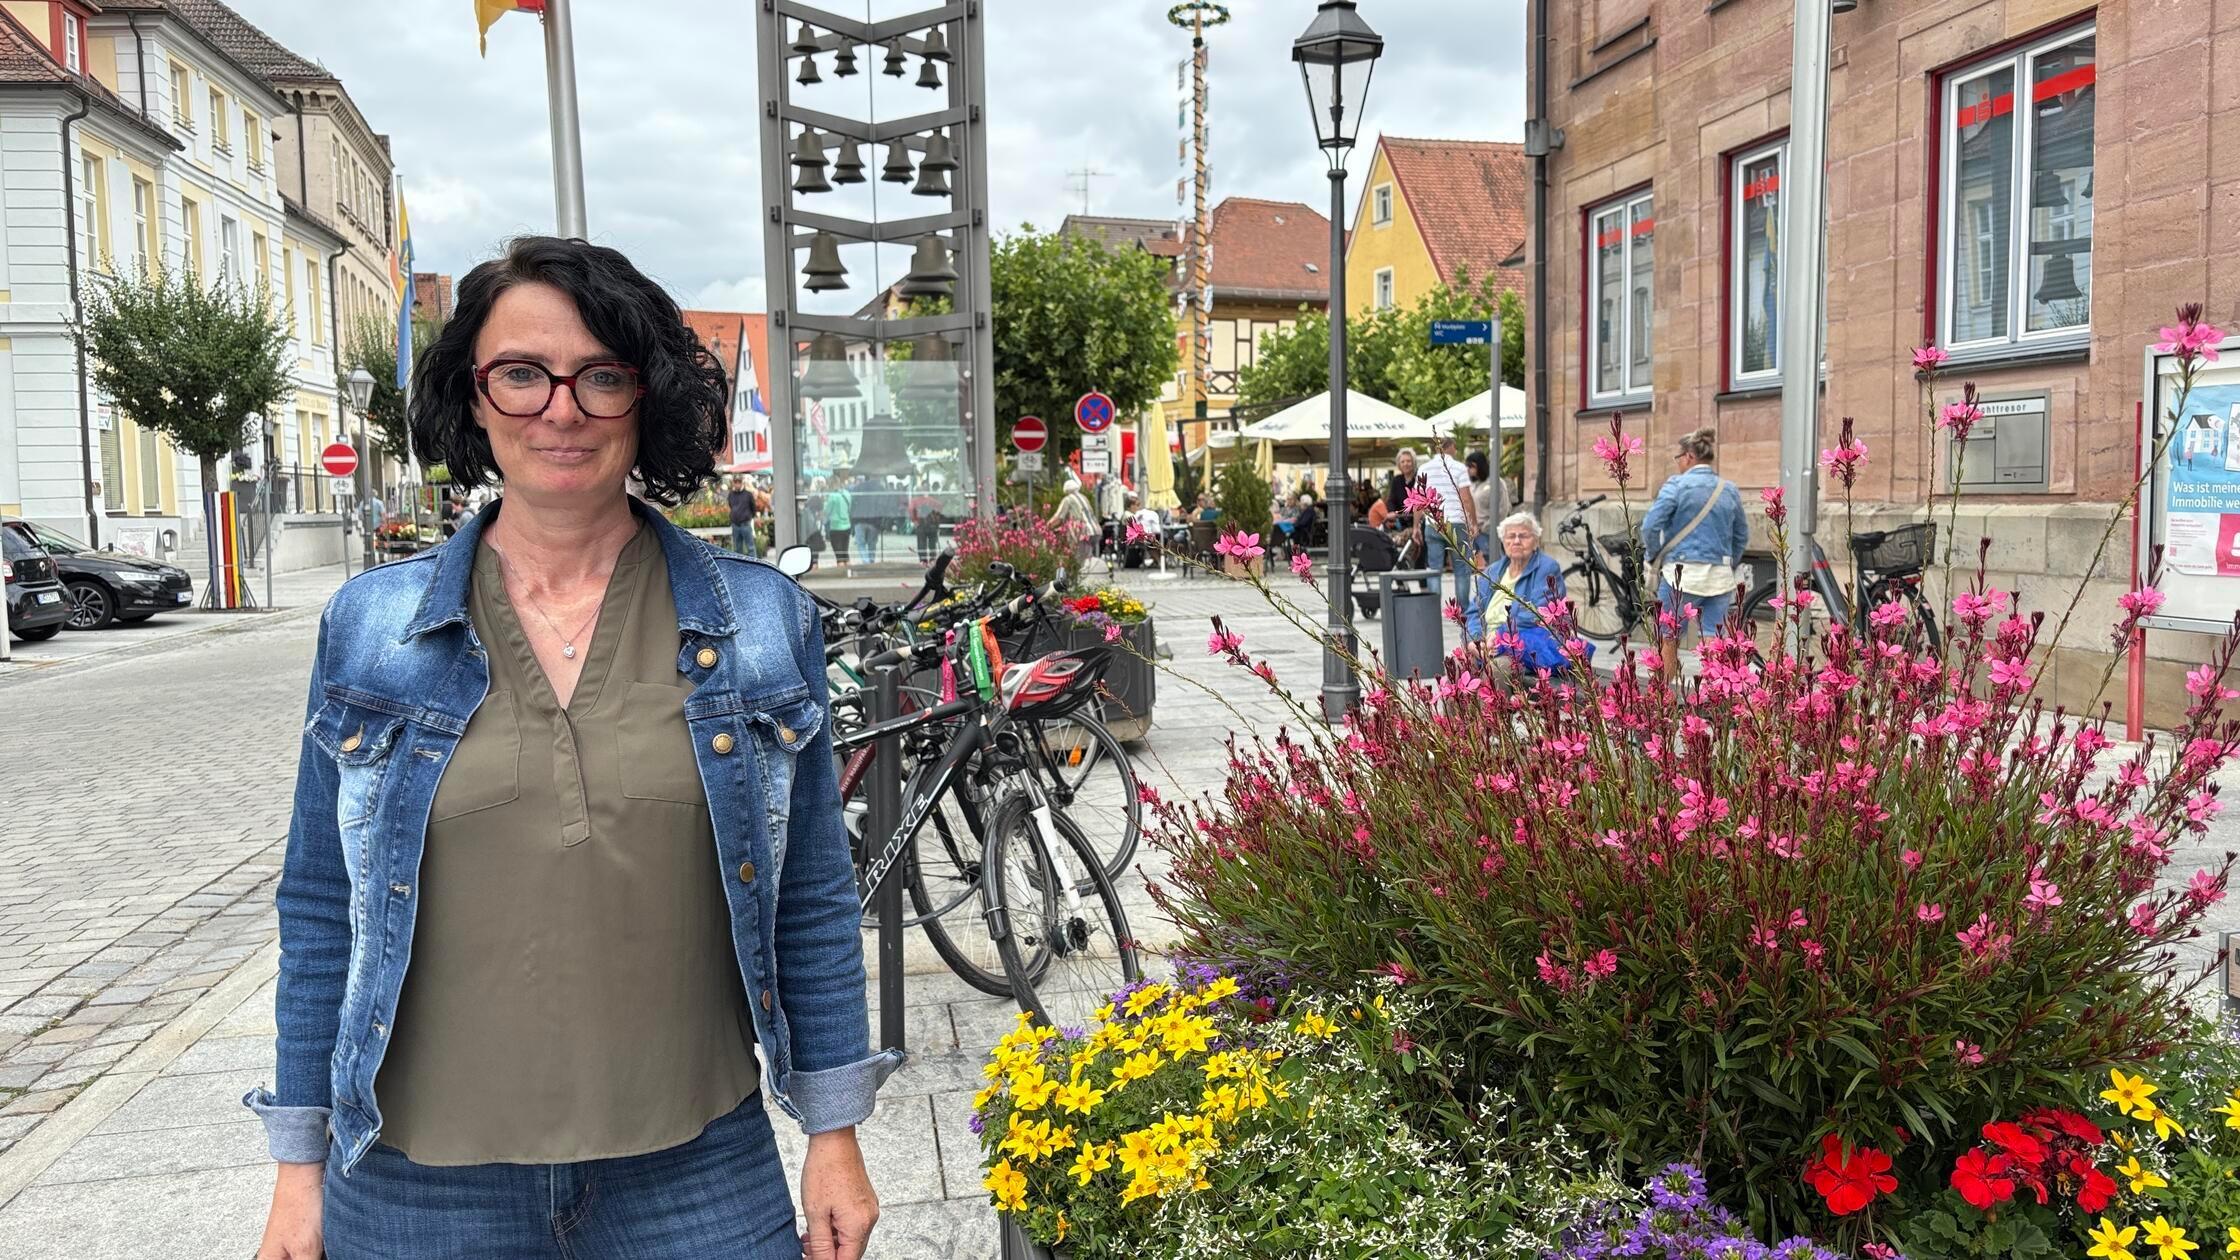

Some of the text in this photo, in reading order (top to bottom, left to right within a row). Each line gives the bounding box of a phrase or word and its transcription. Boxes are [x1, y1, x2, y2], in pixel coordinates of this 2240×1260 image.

[1971, 403, 2027, 415] chttresor
[2173, 481, 2194, 493] Was
[2197, 481, 2210, 493] ist
[2172, 496, 2222, 509] Immobilie
[866, 793, 929, 892] RIXE
